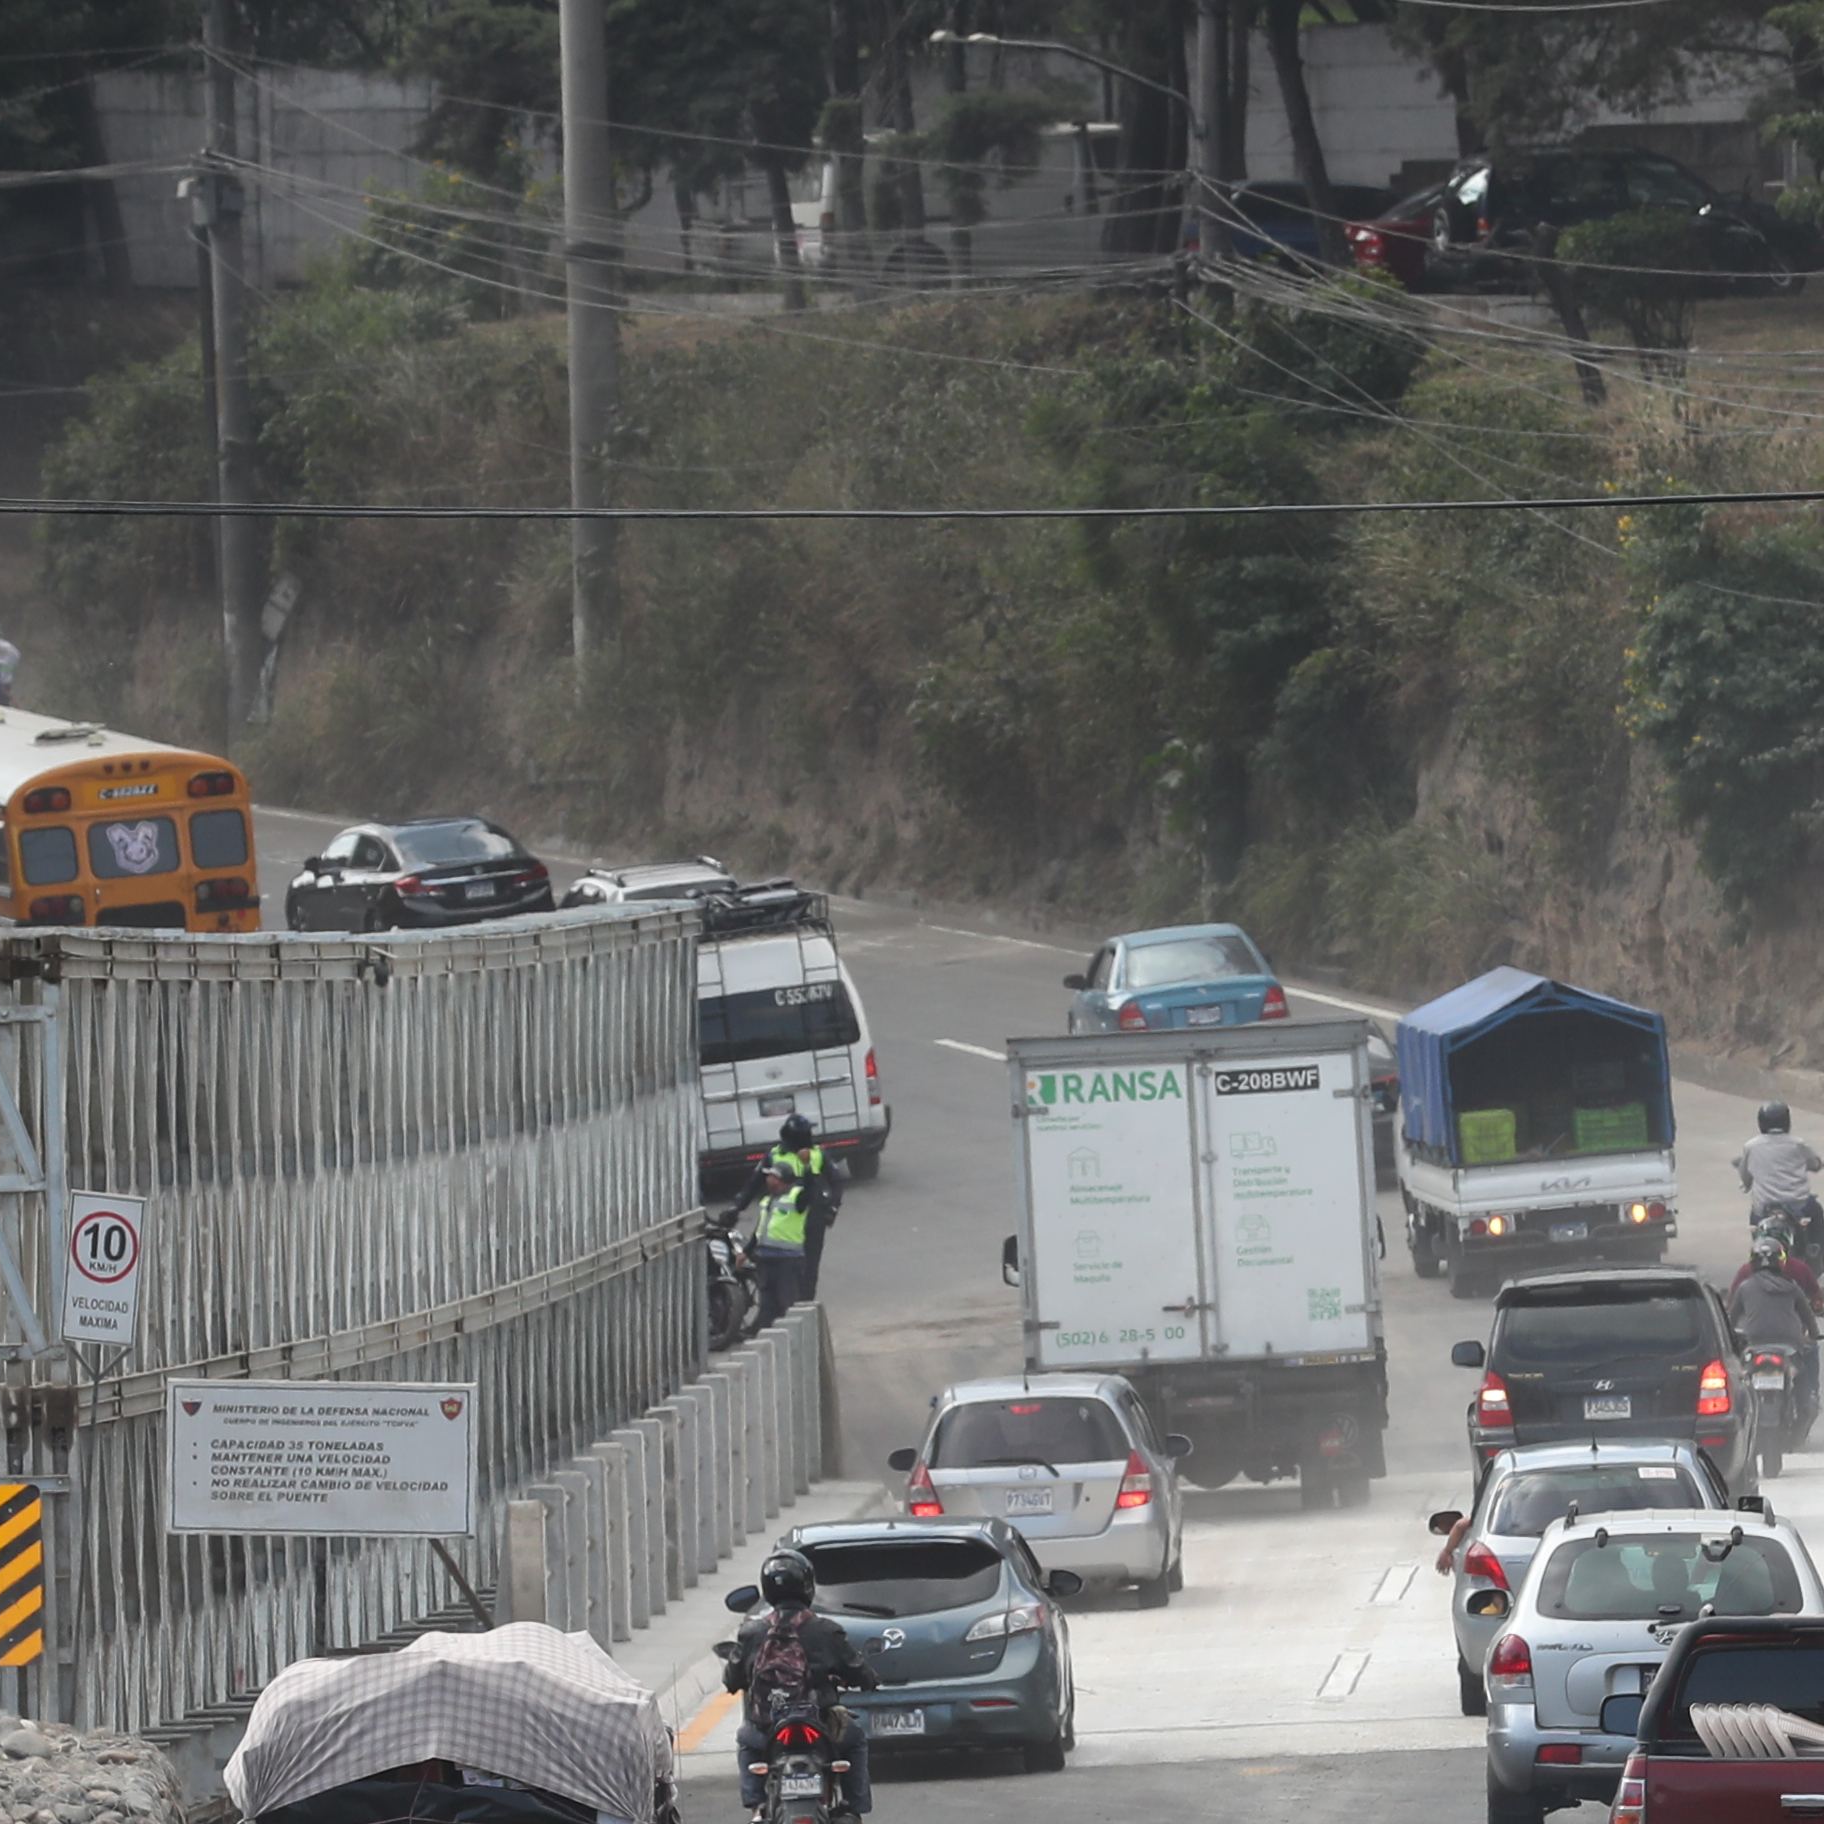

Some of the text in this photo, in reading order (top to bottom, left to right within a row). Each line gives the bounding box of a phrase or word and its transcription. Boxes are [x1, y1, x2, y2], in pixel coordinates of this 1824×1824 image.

[1063, 1070, 1182, 1104] RANSA
[1216, 1068, 1319, 1093] C-208BWF
[84, 1222, 127, 1261] 10
[89, 1261, 117, 1273] KM/H
[71, 1296, 129, 1314] VELOCIDAD
[79, 1316, 119, 1330] MAXIMA
[212, 1404, 430, 1417] MINISTERIO DE LA DEFENSA NACIONAL
[223, 1417, 256, 1425] CUERPO
[271, 1418, 321, 1426] INGENIEROS
[210, 1439, 384, 1451] CAPACIDAD 35 TONELADAS
[210, 1452, 391, 1464] MANTENER UNA VELOCIDAD
[210, 1465, 289, 1477] CONSTANTE
[292, 1466, 312, 1478] (10
[210, 1478, 449, 1491] NO REALIZAR CAMBIO DE VELOCIDAD
[210, 1490, 329, 1503] SOBRE EL PUENTE
